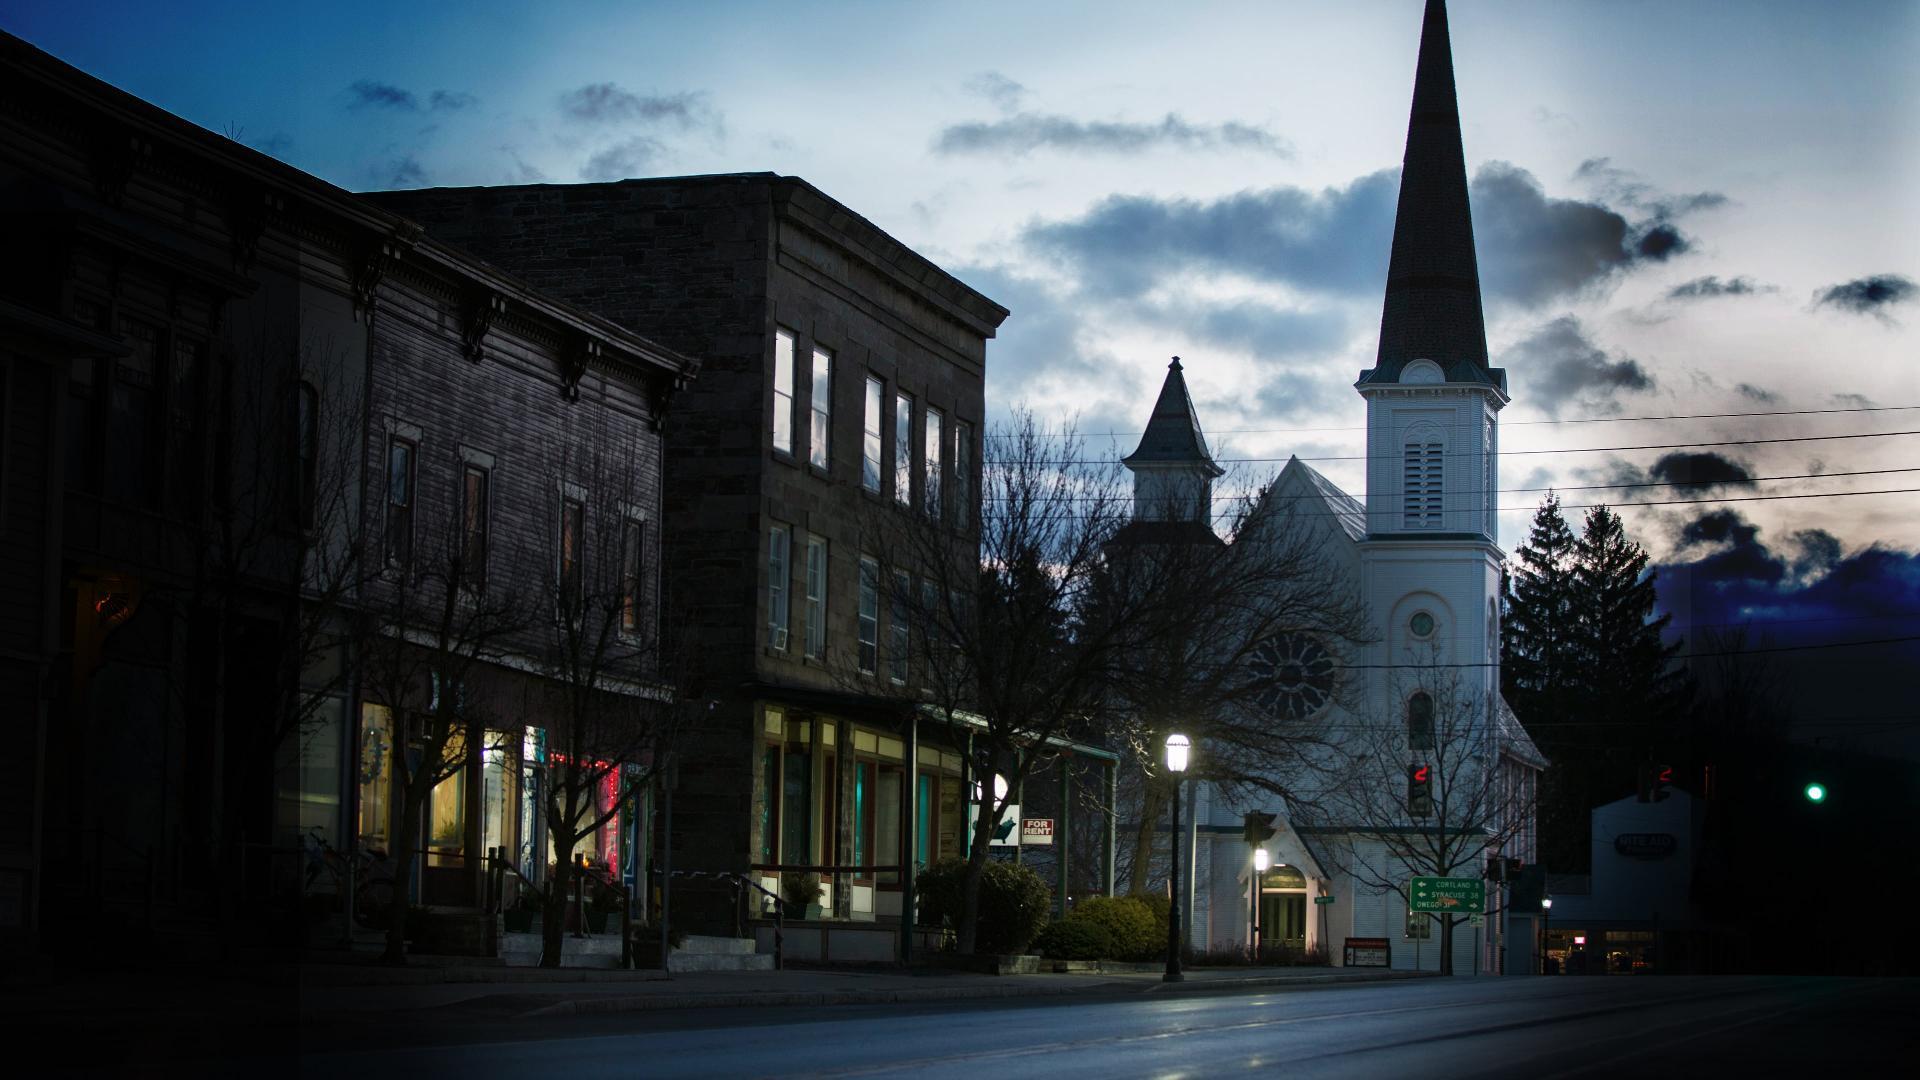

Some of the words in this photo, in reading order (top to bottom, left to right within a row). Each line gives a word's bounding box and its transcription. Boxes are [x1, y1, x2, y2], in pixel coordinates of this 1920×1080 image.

[1027, 820, 1048, 828] FOR
[1023, 827, 1051, 835] RENT
[1435, 881, 1471, 889] CORTLAND
[1431, 891, 1466, 899] SYRACUSE
[1416, 901, 1440, 909] OWEGO
